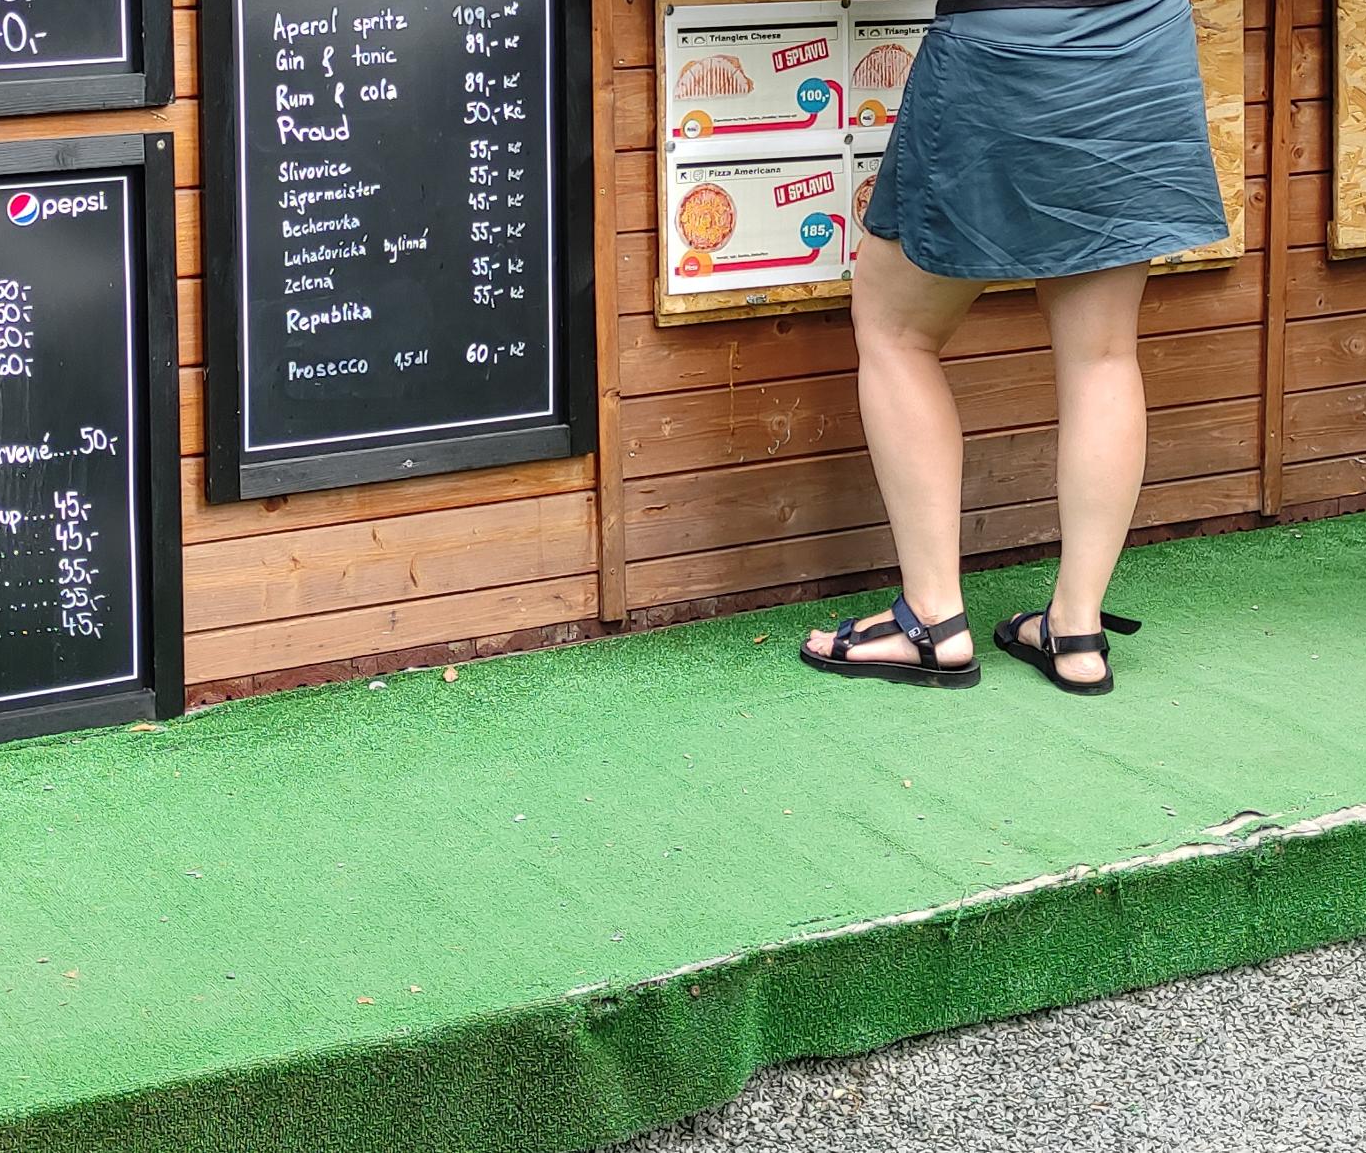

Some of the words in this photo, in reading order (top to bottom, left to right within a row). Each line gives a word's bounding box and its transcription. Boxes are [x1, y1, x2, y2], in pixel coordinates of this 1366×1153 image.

[273, 8, 338, 43] Aperol
[353, 8, 408, 39] spritz
[709, 32, 748, 44] Triangles
[751, 31, 782, 41] Cheese
[276, 51, 305, 72] Gin
[351, 45, 397, 66] tonic
[774, 54, 784, 71] U
[784, 39, 827, 67] SPLAVU
[276, 85, 315, 112] Rum
[360, 78, 397, 101] cola
[800, 89, 830, 103] 100,-
[277, 114, 350, 145] Proud
[278, 159, 352, 183] Slivovice
[709, 169, 732, 178] Pizza
[734, 165, 782, 176] Americana
[278, 180, 380, 215] Jägermeister
[776, 188, 786, 205] U
[788, 172, 833, 201] SPLAVU
[42, 191, 107, 219] pepsi
[282, 214, 361, 238] Becherovka
[802, 223, 834, 238] 185,-
[284, 234, 368, 267] Luhačovická
[384, 227, 429, 264] bylinná
[286, 301, 372, 334] Republika
[288, 358, 369, 381] Prosecco
